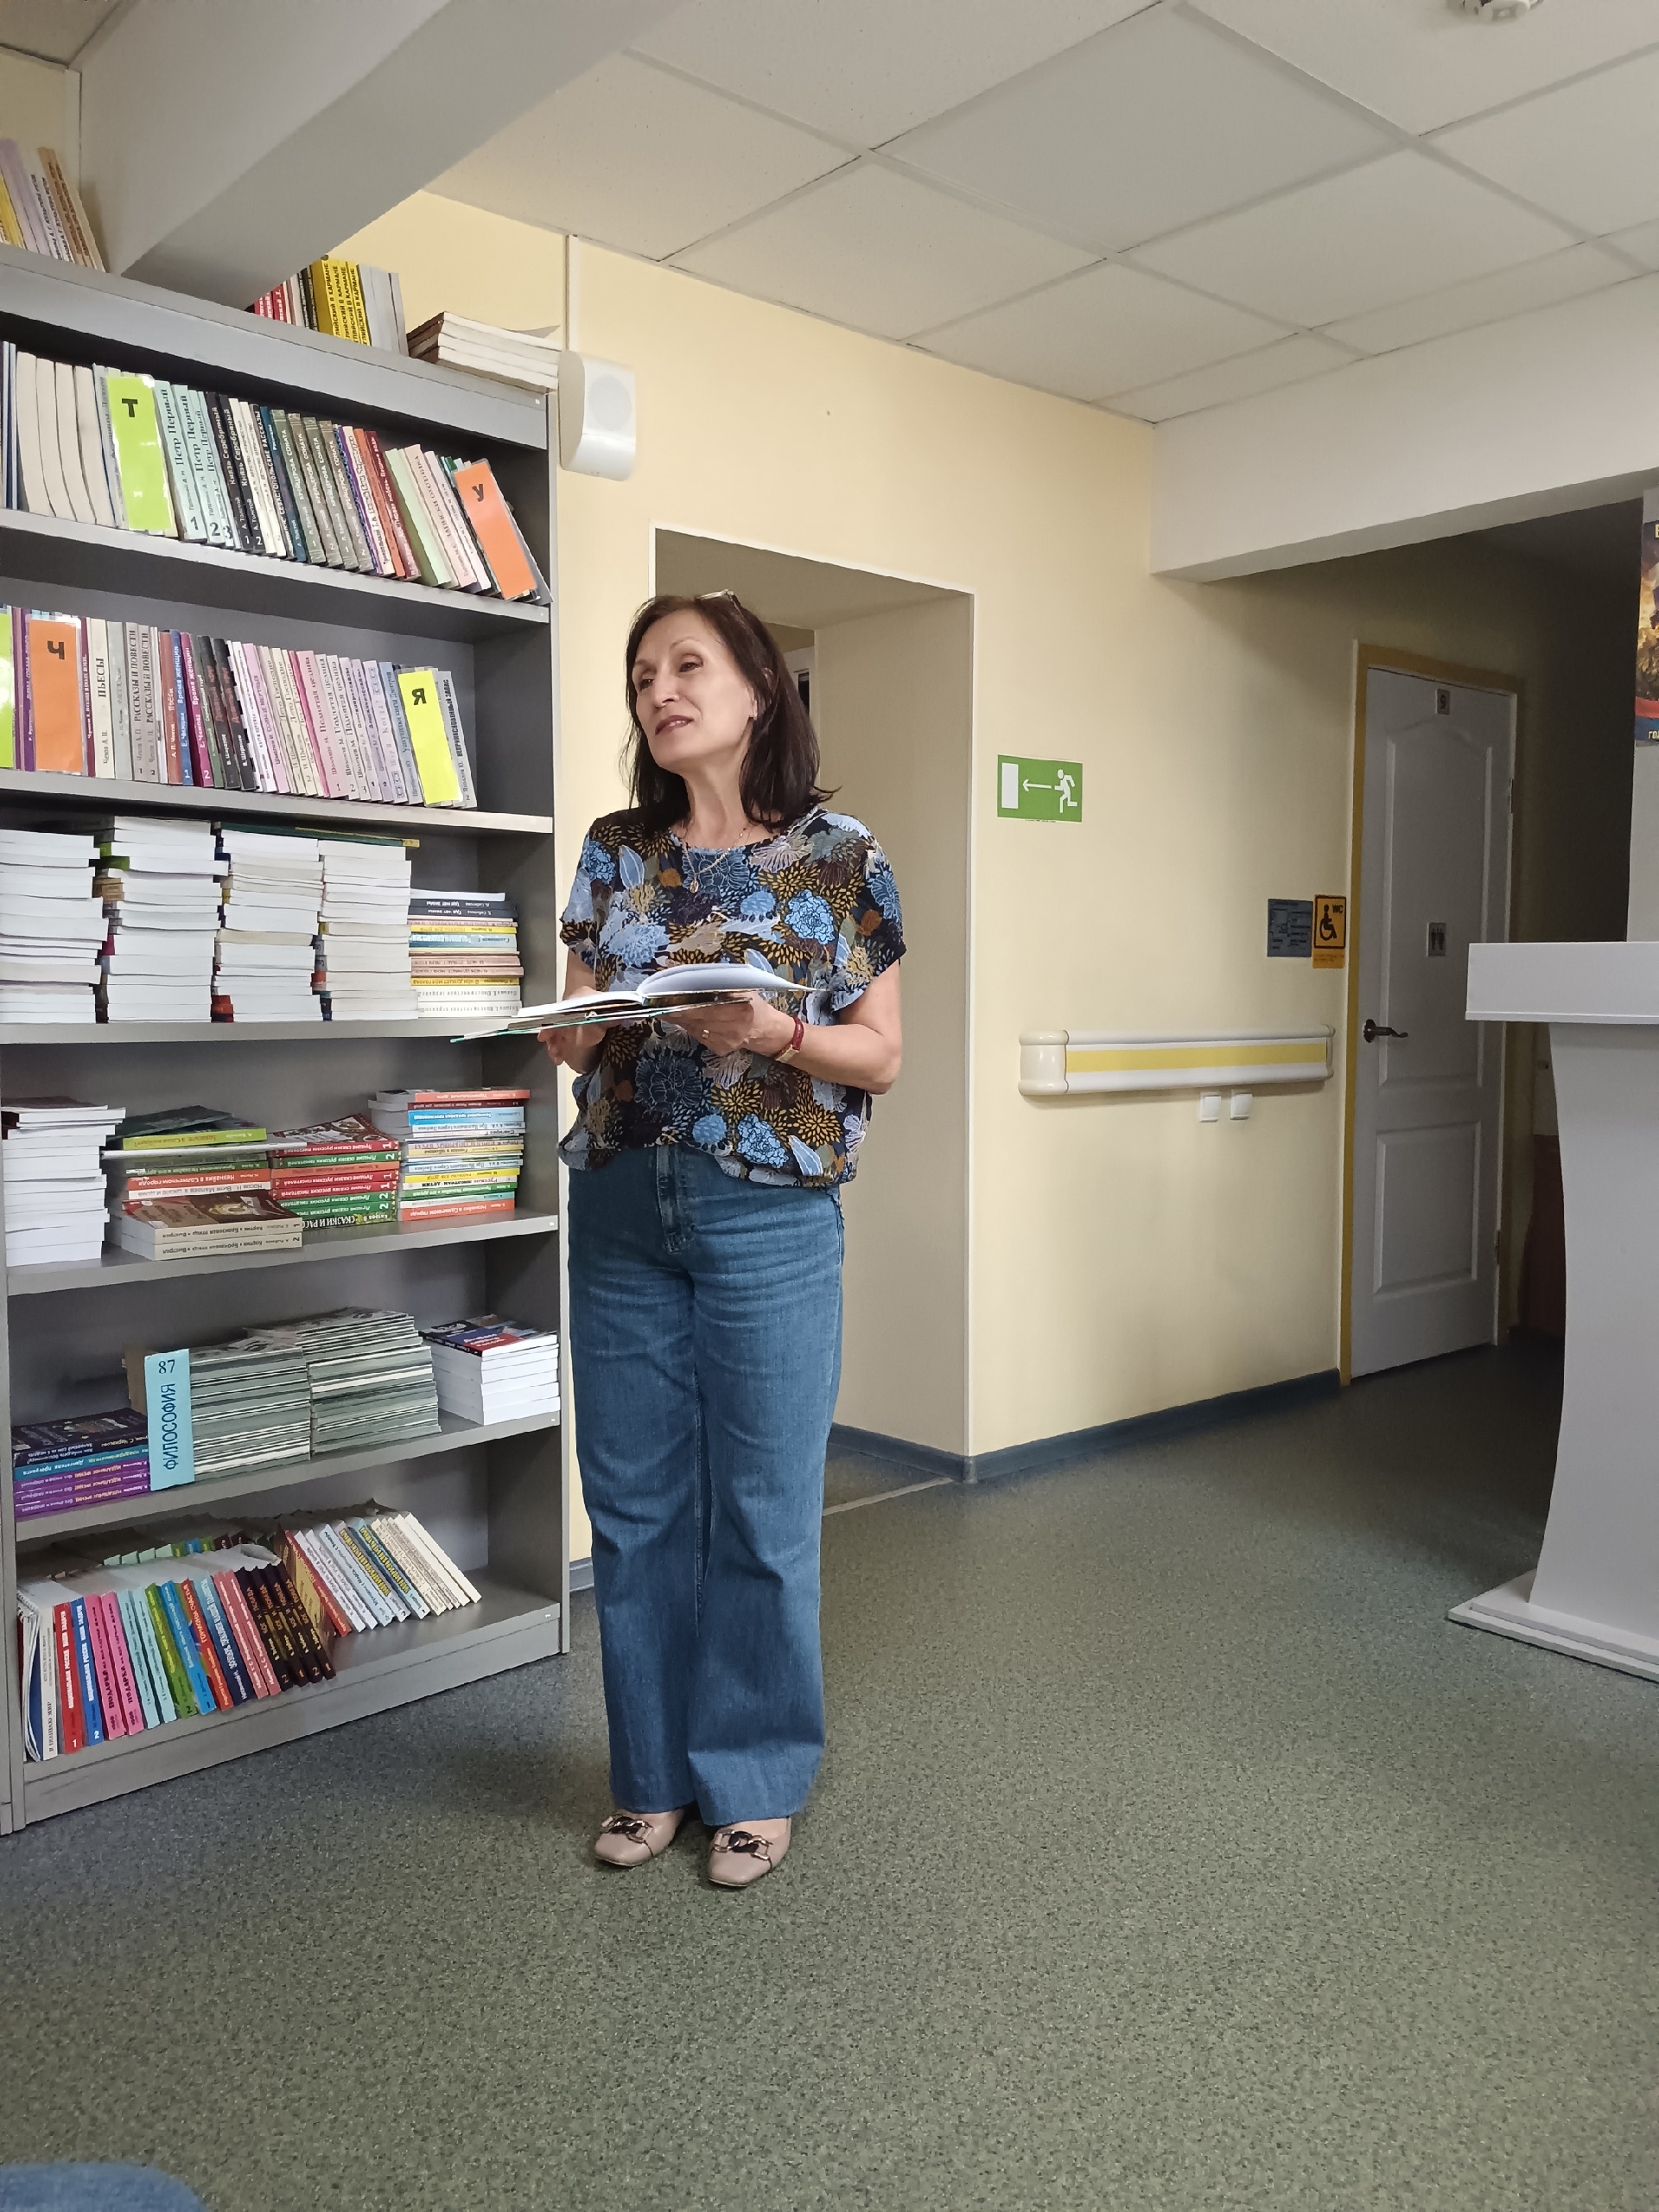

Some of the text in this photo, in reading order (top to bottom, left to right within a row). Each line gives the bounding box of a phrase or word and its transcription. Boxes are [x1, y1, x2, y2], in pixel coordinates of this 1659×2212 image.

[122, 398, 138, 418] Т
[211, 407, 229, 458] Серебряный
[223, 409, 241, 460] Серебряный
[255, 410, 268, 447] РАССКАЗЫ
[281, 429, 292, 455] СОНАТА
[161, 389, 198, 530] 1 Петр Первый
[180, 395, 220, 536] 2 Петр Первый
[194, 410, 233, 539] 3 Петр Первый
[226, 460, 235, 484] Князь
[238, 462, 247, 486] Князь
[289, 458, 304, 499] КРЕЙЦЕРОВА
[298, 433, 321, 504] КРЕЙЦЕРОВА СОНАТА
[313, 437, 336, 506] КРЕЙЦЕРОВА СОНАТА
[329, 440, 353, 509] КРЕЙЦЕРОВА СОНАТА
[264, 450, 284, 515] СЕВАСТОПОЛЬСКИЕ
[472, 484, 485, 502] У
[255, 536, 263, 544] 2
[48, 640, 65, 660] Ч
[129, 630, 137, 669] ПОВЕСТИ
[141, 632, 149, 671] ПОВЕСТИ
[185, 647, 194, 679] женщин
[95, 658, 106, 697] ПЬЕСЫ
[319, 658, 330, 688] целина
[332, 661, 342, 691] целина
[442, 679, 451, 697] ЗАПАС
[131, 679, 141, 721] РАССКАЗЫ
[143, 681, 153, 722] РАССКАЗЫ
[190, 681, 199, 705] Время
[305, 657, 326, 732] Поднятая целина
[411, 688, 426, 706] Я
[327, 692, 340, 734] Поднятая
[339, 694, 353, 735] Поднятая
[353, 748, 363, 778] Шолохов
[327, 1215, 355, 1225] СКАЗКИ
[159, 1359, 176, 1375] 87
[161, 1383, 178, 1470] ФИЛОСОФИЯ
[259, 1584, 273, 1609] ПОБЕДА
[285, 1579, 299, 1603] ПОБЕДА
[183, 1583, 207, 1643] ГОРМОНЫ СЧАСТЬЯ
[312, 1667, 319, 1675] 2
